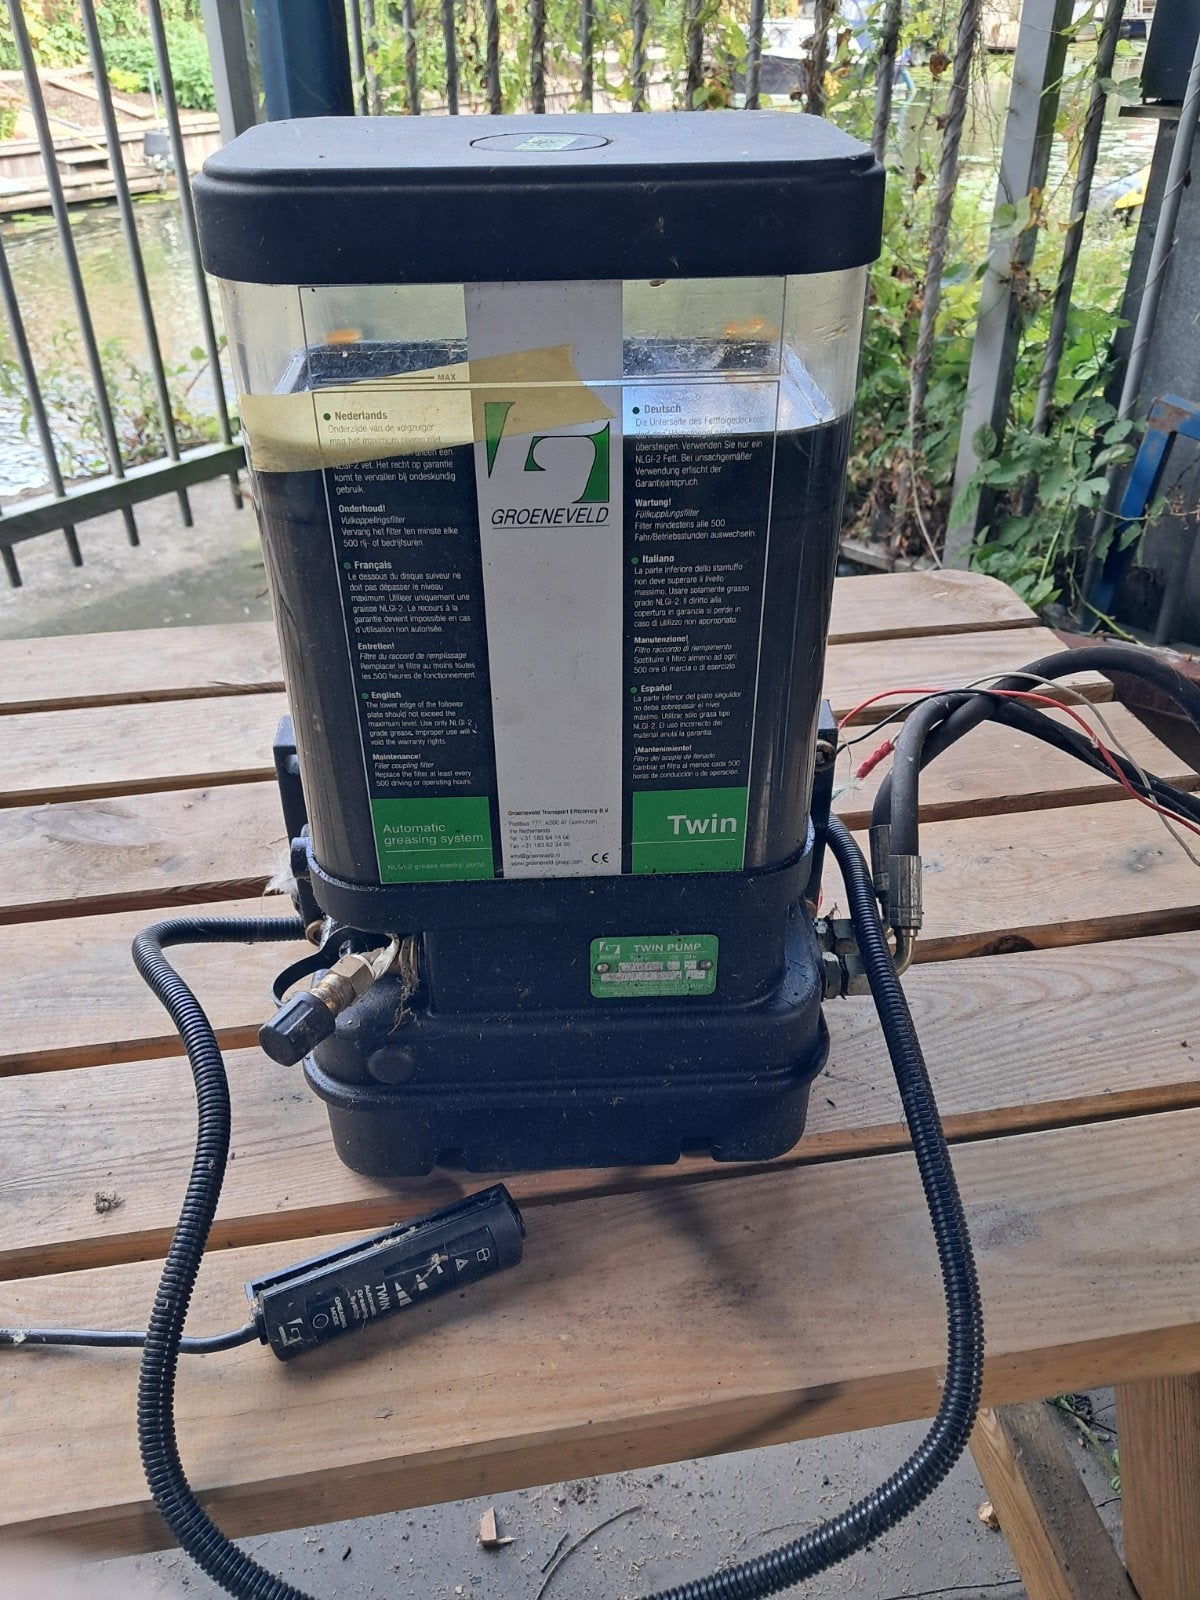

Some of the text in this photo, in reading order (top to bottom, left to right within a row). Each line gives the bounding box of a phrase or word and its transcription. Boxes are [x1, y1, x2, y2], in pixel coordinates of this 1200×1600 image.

[644, 404, 681, 414] Deutsch
[334, 410, 388, 420] Nederlands
[635, 419, 648, 427] Die
[681, 441, 722, 450] Verwenden
[724, 440, 736, 449] Sie
[751, 440, 763, 448] ein
[681, 454, 693, 462] Bei
[361, 460, 453, 471] vet. Het recht op garantie
[635, 466, 680, 477] Verwendung
[710, 465, 722, 473] der
[334, 472, 456, 483] komt te vervallen bij ondeskundig
[336, 485, 365, 496] gebruik.
[338, 504, 386, 513] Onderhoud!
[635, 498, 672, 509] Wartung!
[341, 516, 406, 526] Vulkoppelingsfilter
[492, 507, 608, 524] GROENEVELD
[634, 518, 726, 530] Filter mindestens alle 500
[342, 528, 371, 538] Vervang
[386, 527, 401, 535] filter
[404, 527, 416, 535] ten
[418, 527, 441, 535] minste
[443, 526, 458, 534] elke
[343, 539, 379, 547] 500 of
[642, 554, 675, 563] Italiano
[354, 560, 392, 571] Français
[359, 572, 450, 582] dessous disque suiveur
[350, 582, 444, 593] doit pas dépasser niveau
[354, 615, 381, 625] garantie
[383, 614, 408, 622] devient
[410, 614, 446, 624] impossible
[634, 635, 688, 644] Manutenzione!
[358, 642, 395, 650] Entretien!
[640, 683, 672, 694] Español
[371, 690, 402, 701] English
[399, 700, 416, 710] edge
[367, 710, 383, 720] plate
[420, 709, 444, 717] exceed
[445, 709, 456, 717] the
[368, 719, 400, 727] maximum
[434, 719, 448, 728] only
[369, 729, 388, 738] grade
[415, 728, 444, 737] Improper
[460, 727, 471, 735] will
[397, 737, 426, 747] warranty
[427, 737, 448, 746] rights.
[635, 744, 692, 754] ¡Mantenimiento!
[372, 752, 422, 760] Maintenance!
[375, 770, 400, 779] Replace
[429, 769, 436, 777] at
[454, 770, 471, 778] every
[391, 778, 412, 788] driving
[422, 778, 451, 787] operating
[452, 777, 472, 785] hours.
[383, 824, 446, 833] Automatic
[667, 814, 737, 835] Twin
[385, 834, 483, 847] greasing system
[592, 853, 609, 863] CE
[633, 943, 701, 952] TWIN PUMP
[365, 1285, 376, 1316] Automatic
[375, 1282, 390, 1310] TWIN
[358, 1290, 368, 1318] Greasing
[335, 1297, 347, 1328] GREASING
